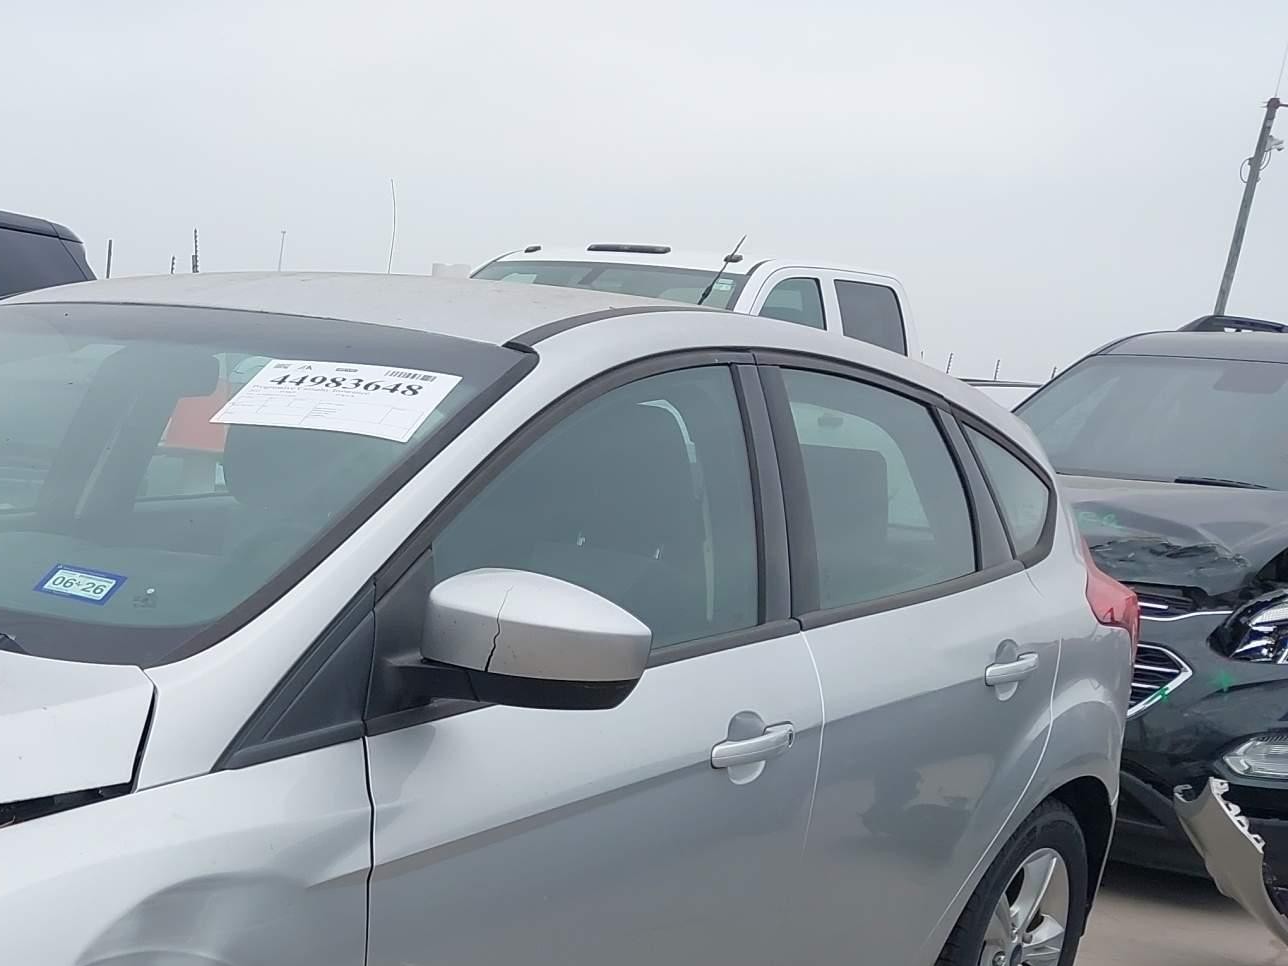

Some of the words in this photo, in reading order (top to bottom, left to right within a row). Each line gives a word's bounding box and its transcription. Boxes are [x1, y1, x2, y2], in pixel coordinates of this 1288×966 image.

[269, 374, 424, 397] 44983648
[52, 576, 75, 589] 06
[81, 582, 107, 595] 26
